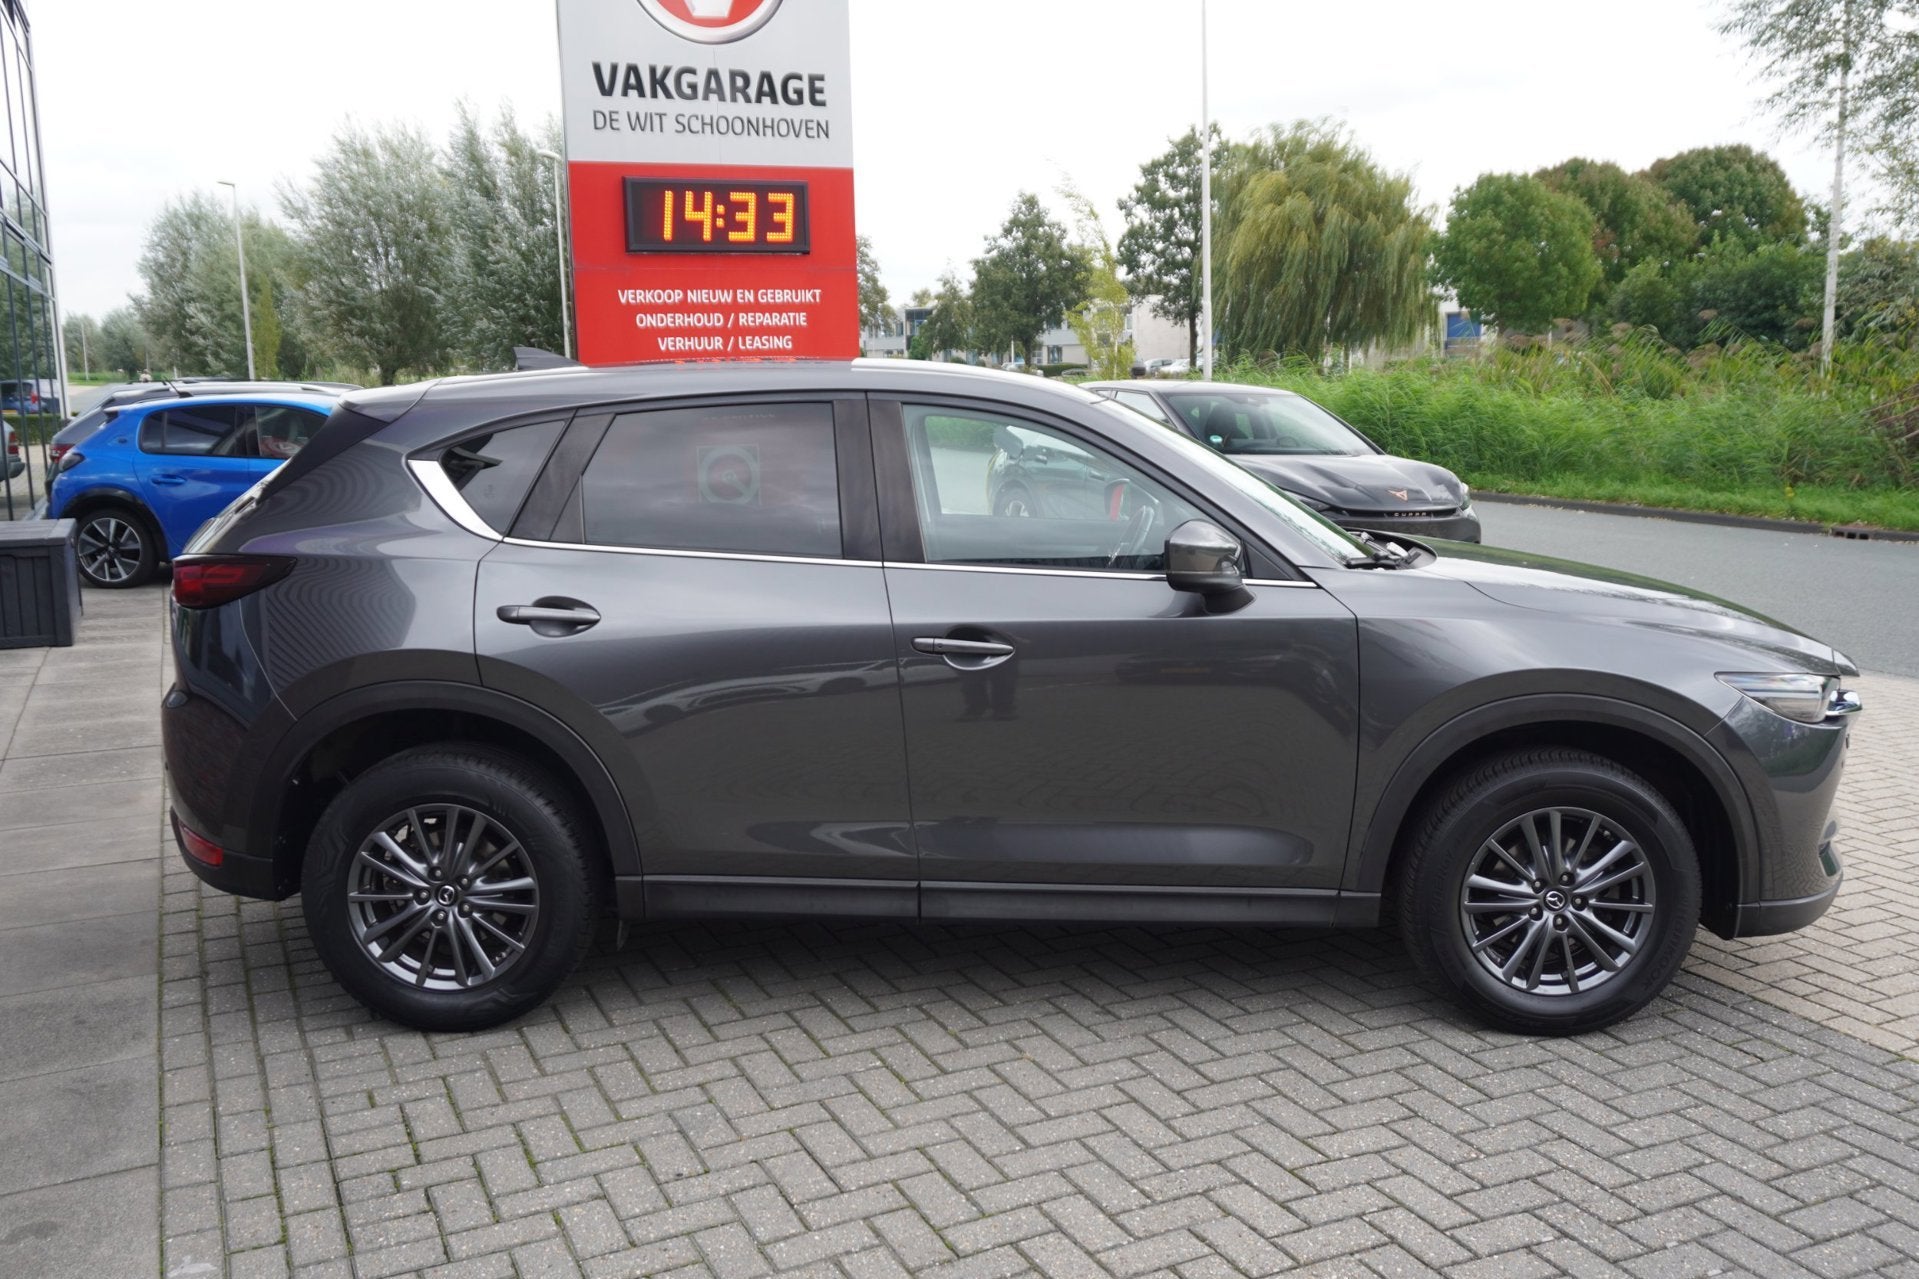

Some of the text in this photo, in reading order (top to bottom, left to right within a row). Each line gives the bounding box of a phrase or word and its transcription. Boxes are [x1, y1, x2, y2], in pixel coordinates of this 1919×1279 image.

[592, 61, 827, 108] VAKGARAGE
[592, 109, 830, 140] DE WIT SCHOONHOVEN
[663, 190, 795, 242] 14:33
[617, 288, 822, 305] VERKOOP NIEUW EN GEBRUIKT
[635, 311, 808, 329] ONDERHOUD / REPARATIE
[657, 335, 793, 352] VERHUUR / LEASING
